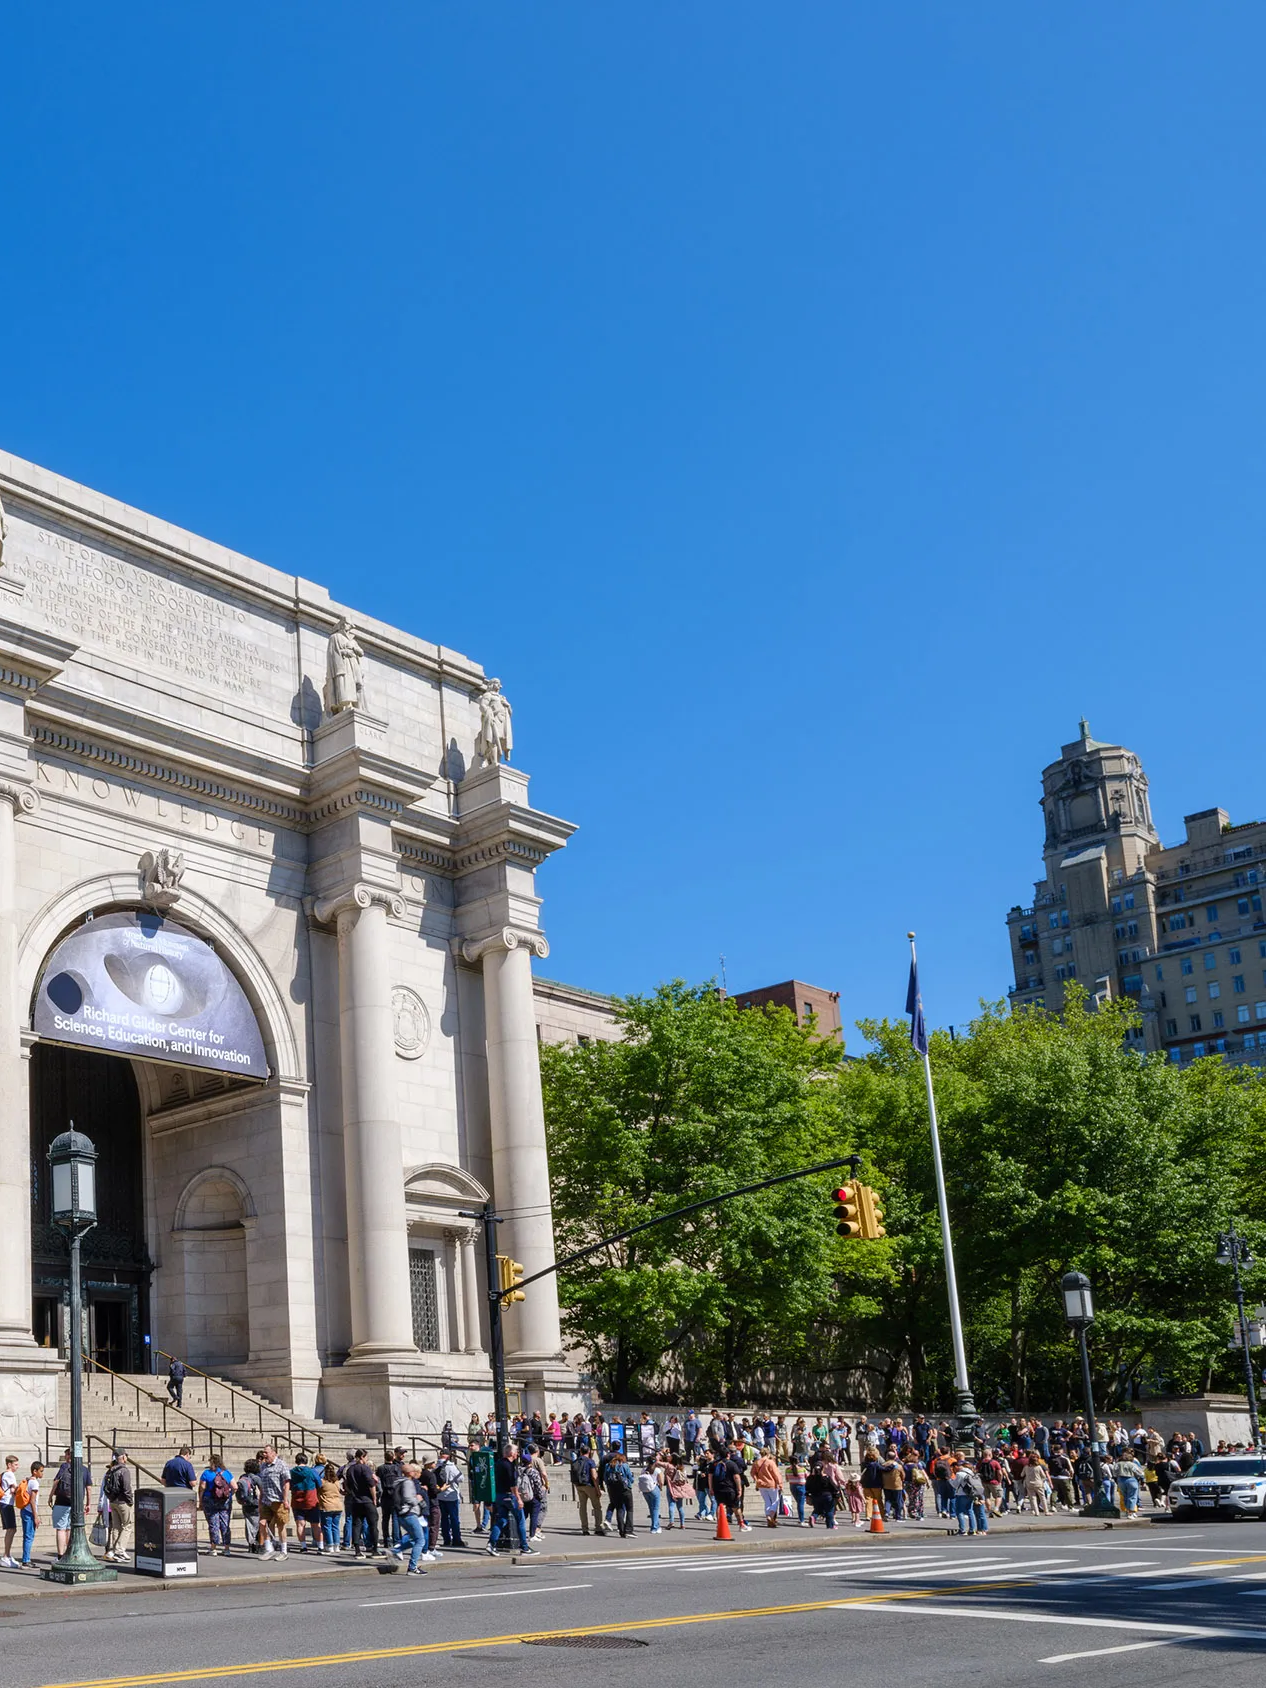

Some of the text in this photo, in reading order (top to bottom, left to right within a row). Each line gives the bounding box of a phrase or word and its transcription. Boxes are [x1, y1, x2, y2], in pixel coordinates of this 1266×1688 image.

[13, 563, 53, 585] ENERGY
[57, 582, 79, 596] AND
[83, 591, 137, 619] FORTITUDE
[142, 613, 152, 624] IN
[156, 619, 173, 633] THE
[177, 627, 203, 644] FAITH
[207, 639, 218, 649] OF
[221, 645, 242, 660] OUR
[245, 653, 280, 673] FATHERS
[25, 556, 259, 655] A GREAT LEADER OF THE YOUTH OF AMERICA
[38, 531, 246, 623] STATE OF NEW YORK MEMORIAL TO
[65, 556, 223, 628] THEODORE ROOSEVELT
[22, 593, 261, 689] IN THE LOVE AND CONSERVATION OF NATURE
[31, 583, 254, 675] IN DEFENSE OF THE RIGHTS OF THE PEOPLE
[44, 613, 245, 694] AND OF THE BEST IN LIFE AND IN MAN
[34, 758, 271, 848] KNOWLEDGE
[54, 1015, 251, 1065] Science, Education, and Innovation
[82, 1004, 225, 1045] Richard Gilder Center for
